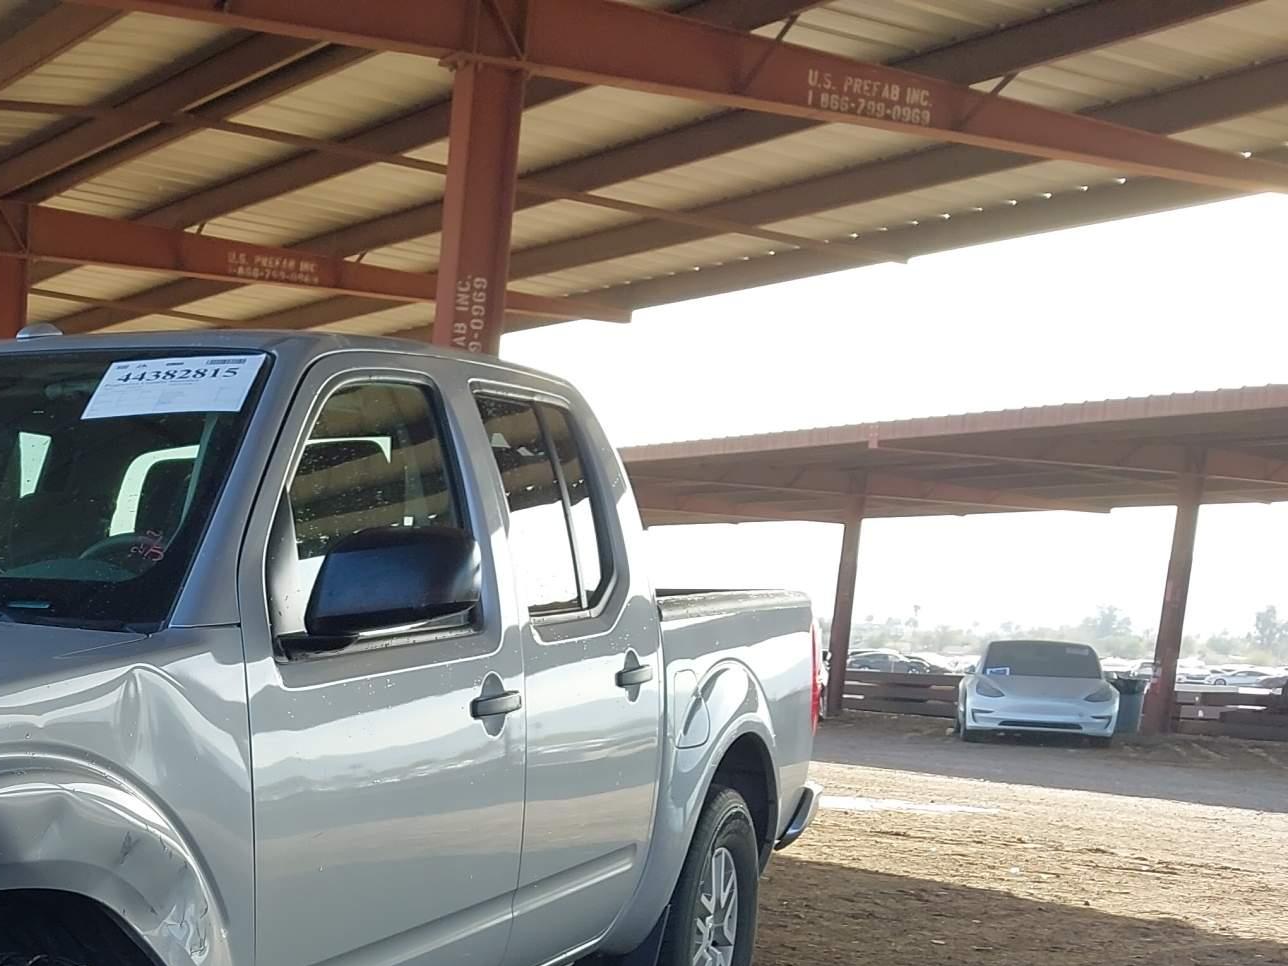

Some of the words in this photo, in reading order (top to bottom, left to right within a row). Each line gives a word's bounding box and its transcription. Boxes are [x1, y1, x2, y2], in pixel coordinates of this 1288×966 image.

[808, 69, 836, 91] U.S.
[843, 76, 899, 101] PREFAB
[906, 87, 933, 107] INC.
[455, 274, 472, 312] INC.
[117, 367, 240, 382] 44382815
